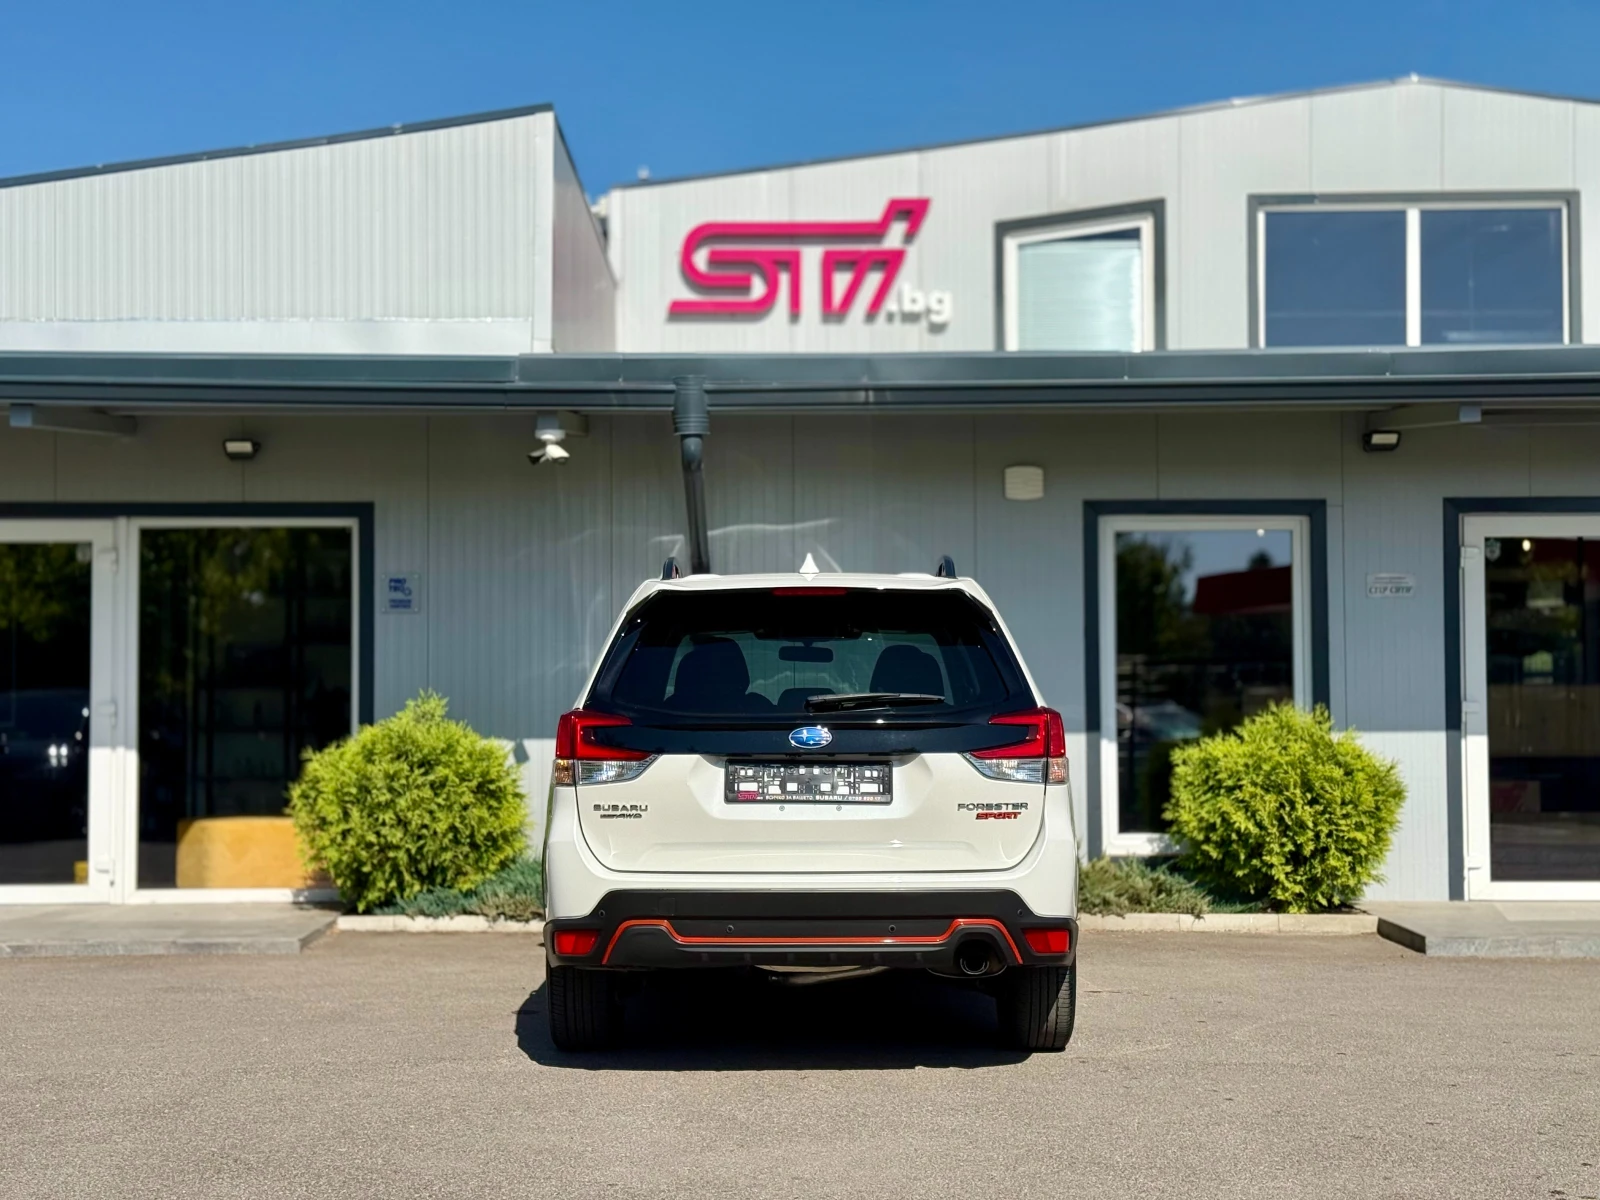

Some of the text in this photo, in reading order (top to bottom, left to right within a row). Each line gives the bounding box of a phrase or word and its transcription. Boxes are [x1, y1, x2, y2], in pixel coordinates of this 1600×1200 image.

[593, 804, 648, 812] SUBARU
[957, 803, 1029, 811] FORESTER
[975, 812, 1022, 820] SPORT
